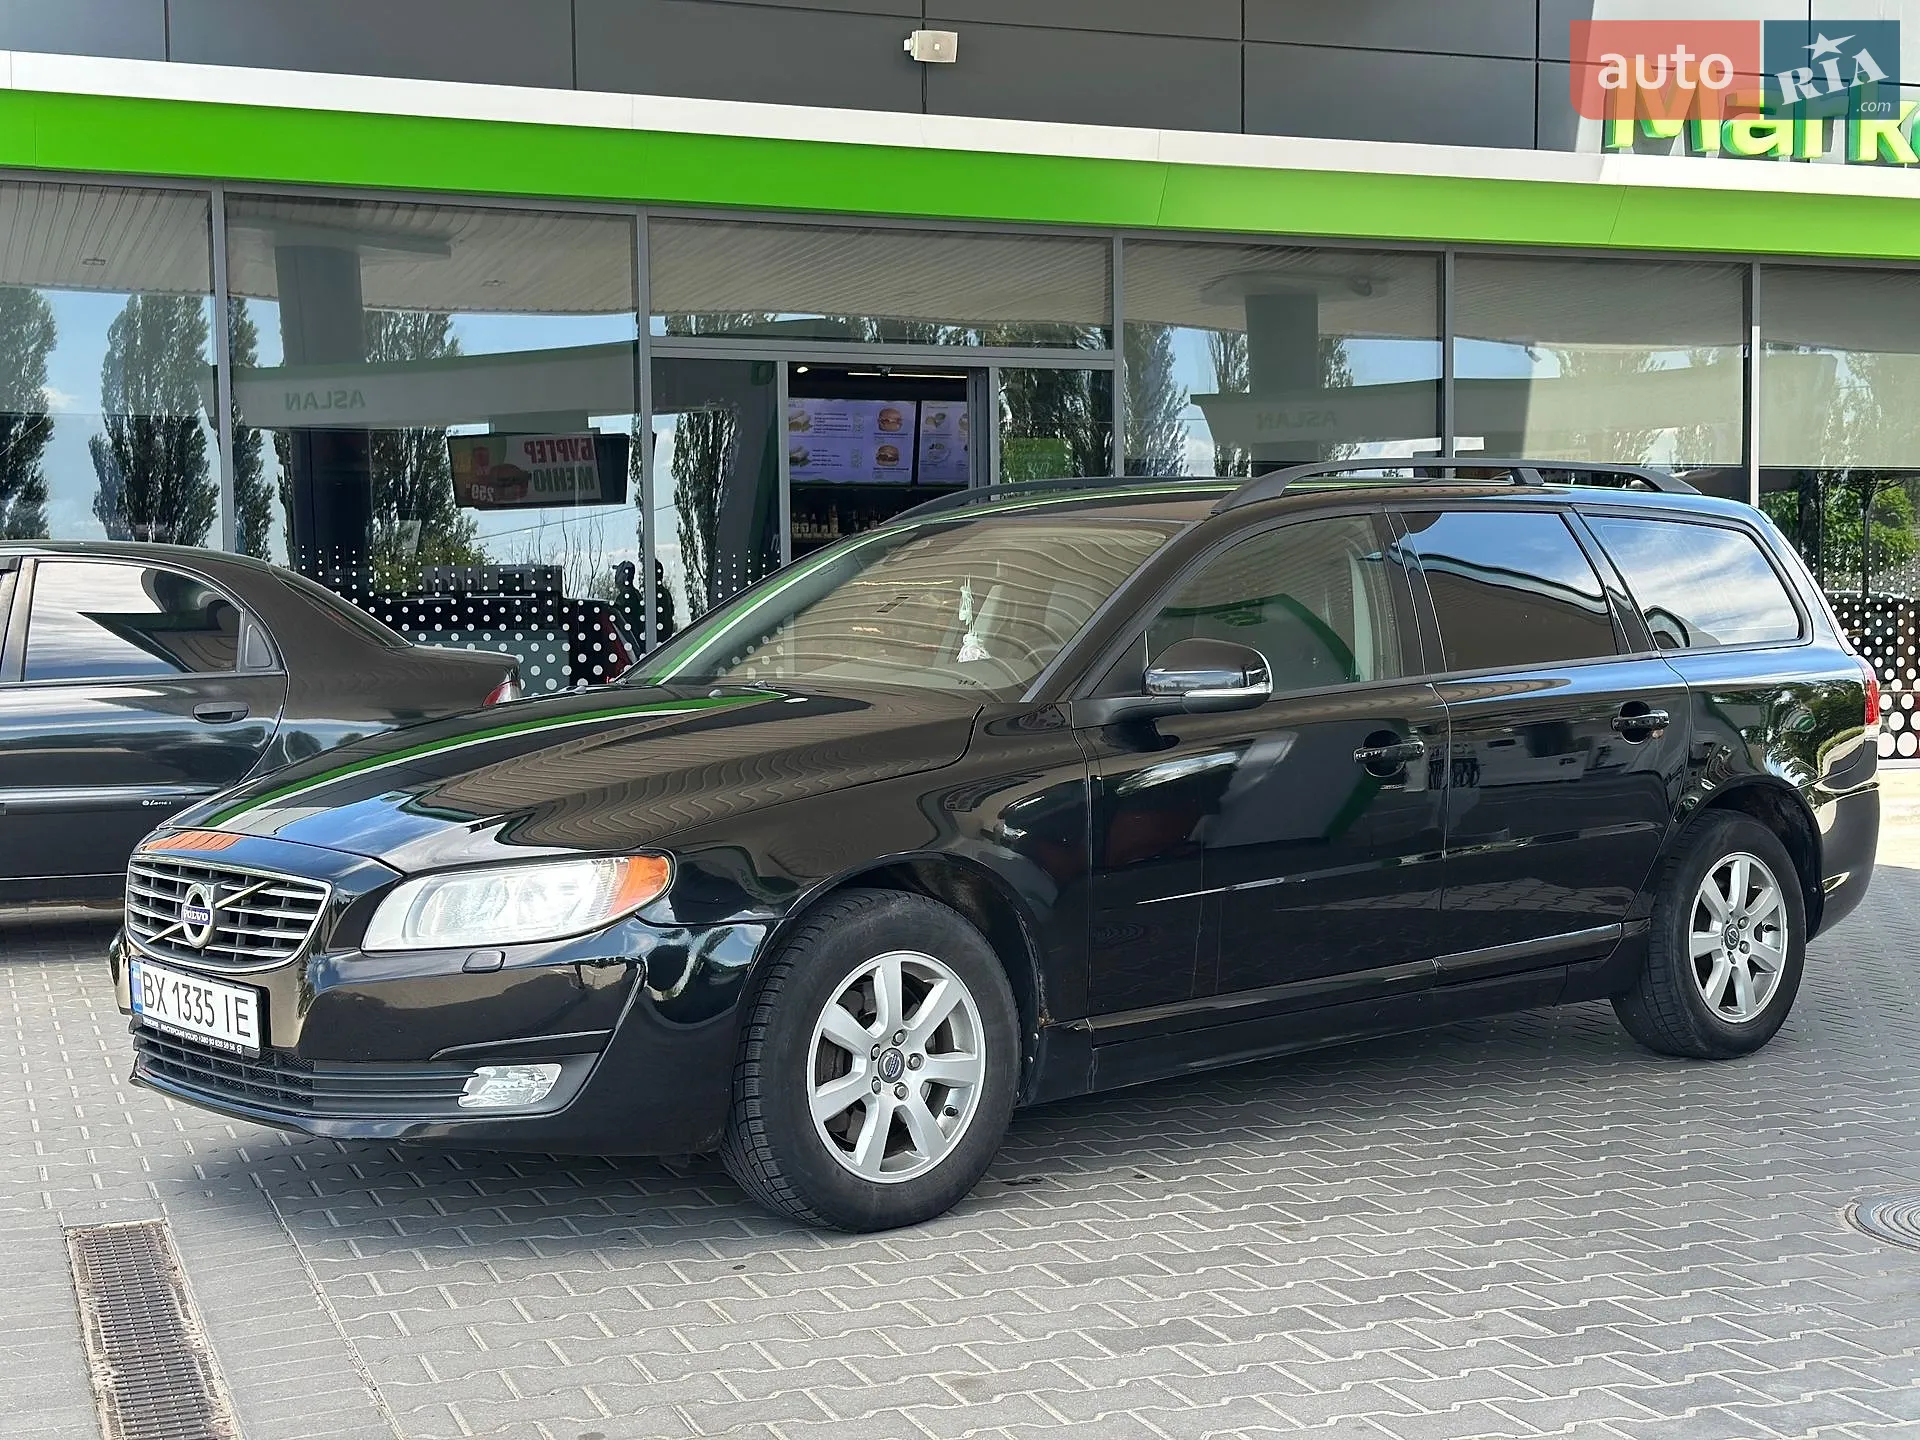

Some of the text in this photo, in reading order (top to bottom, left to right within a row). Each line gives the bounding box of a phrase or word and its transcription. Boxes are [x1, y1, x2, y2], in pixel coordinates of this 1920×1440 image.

[1604, 58, 1920, 164] Mark
[184, 909, 208, 922] VOLVO
[142, 971, 168, 1015] BX
[172, 981, 215, 1028] 1335
[225, 994, 251, 1038] IE
